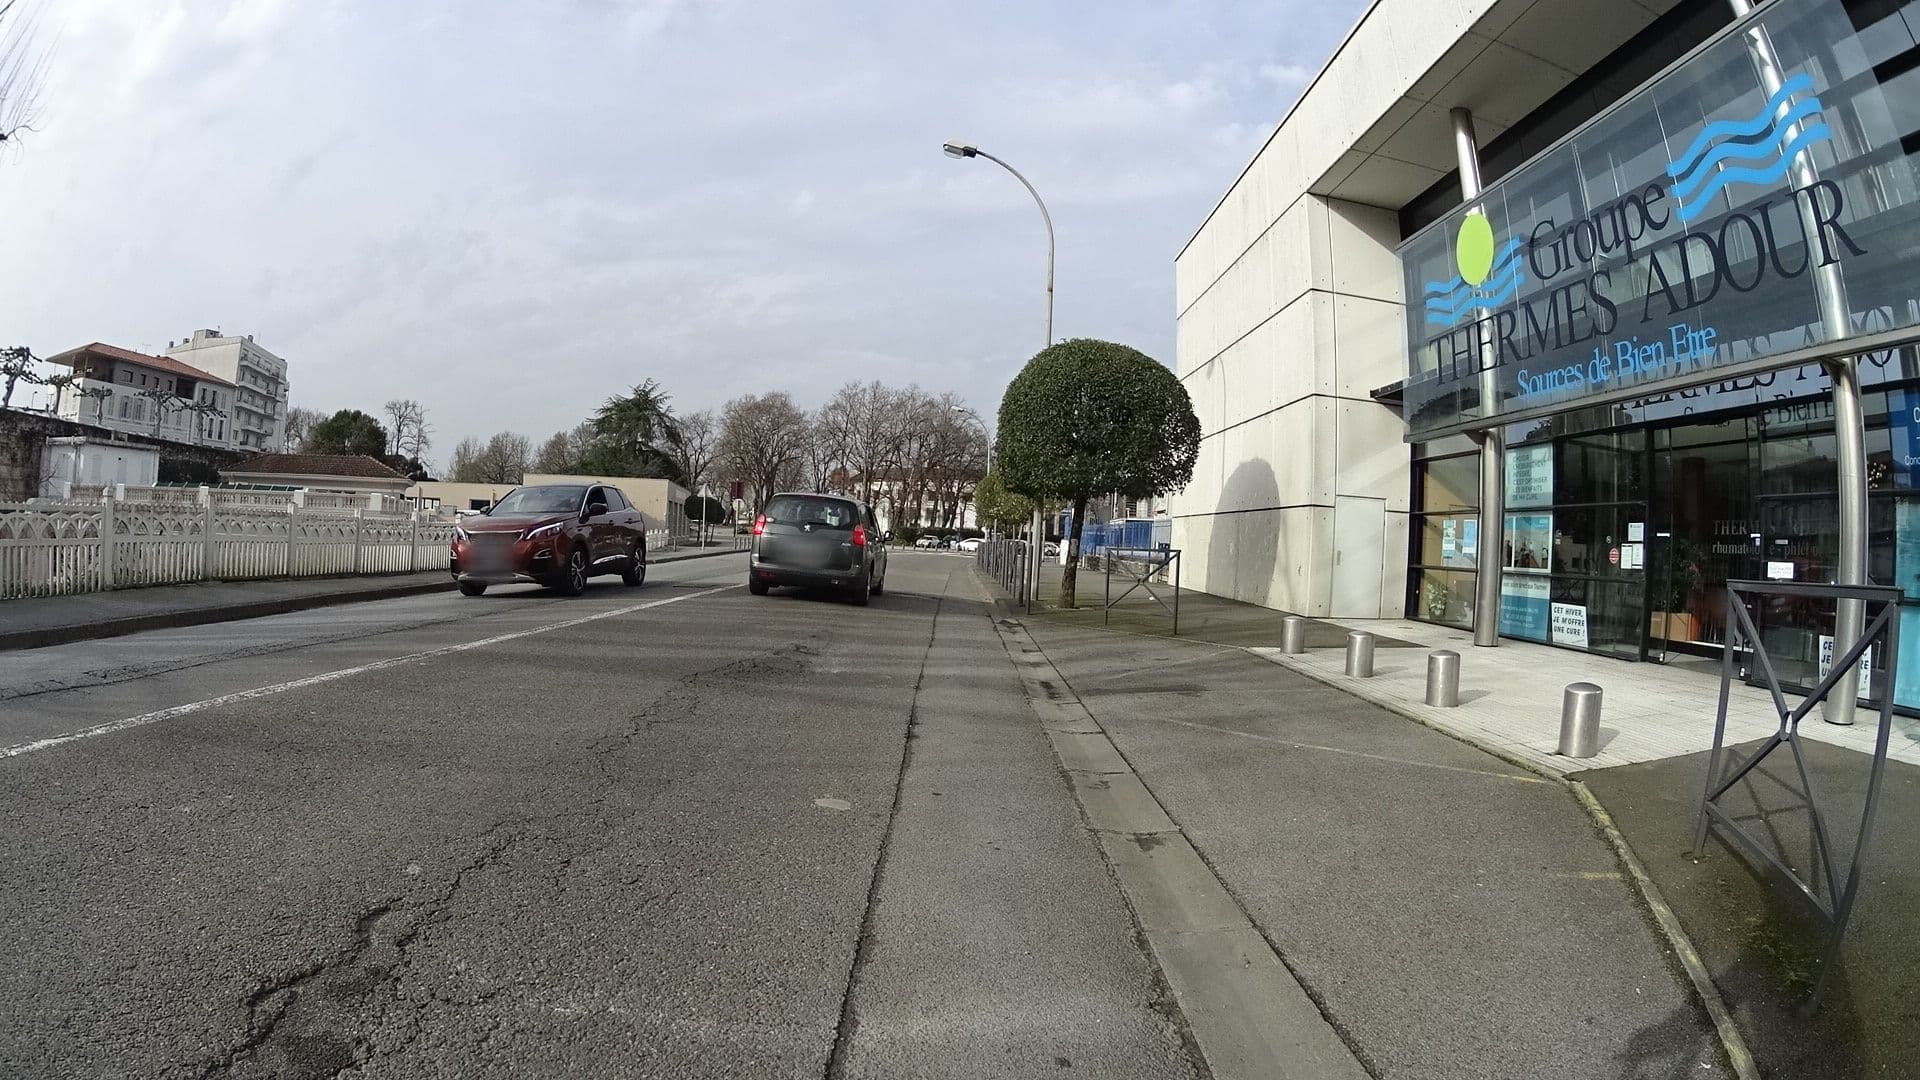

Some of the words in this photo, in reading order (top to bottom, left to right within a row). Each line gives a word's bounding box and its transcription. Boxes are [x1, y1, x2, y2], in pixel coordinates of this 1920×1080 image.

[1528, 183, 1669, 280] Groupe
[1429, 269, 1617, 387] THERMES
[1640, 179, 1868, 324] ADOUR
[1517, 363, 1584, 398] Sources
[1588, 347, 1611, 383] de
[1614, 336, 1666, 377] Bien
[1668, 323, 1718, 363] Etre
[1554, 606, 1564, 614] CET
[1567, 627, 1581, 636] CURE
